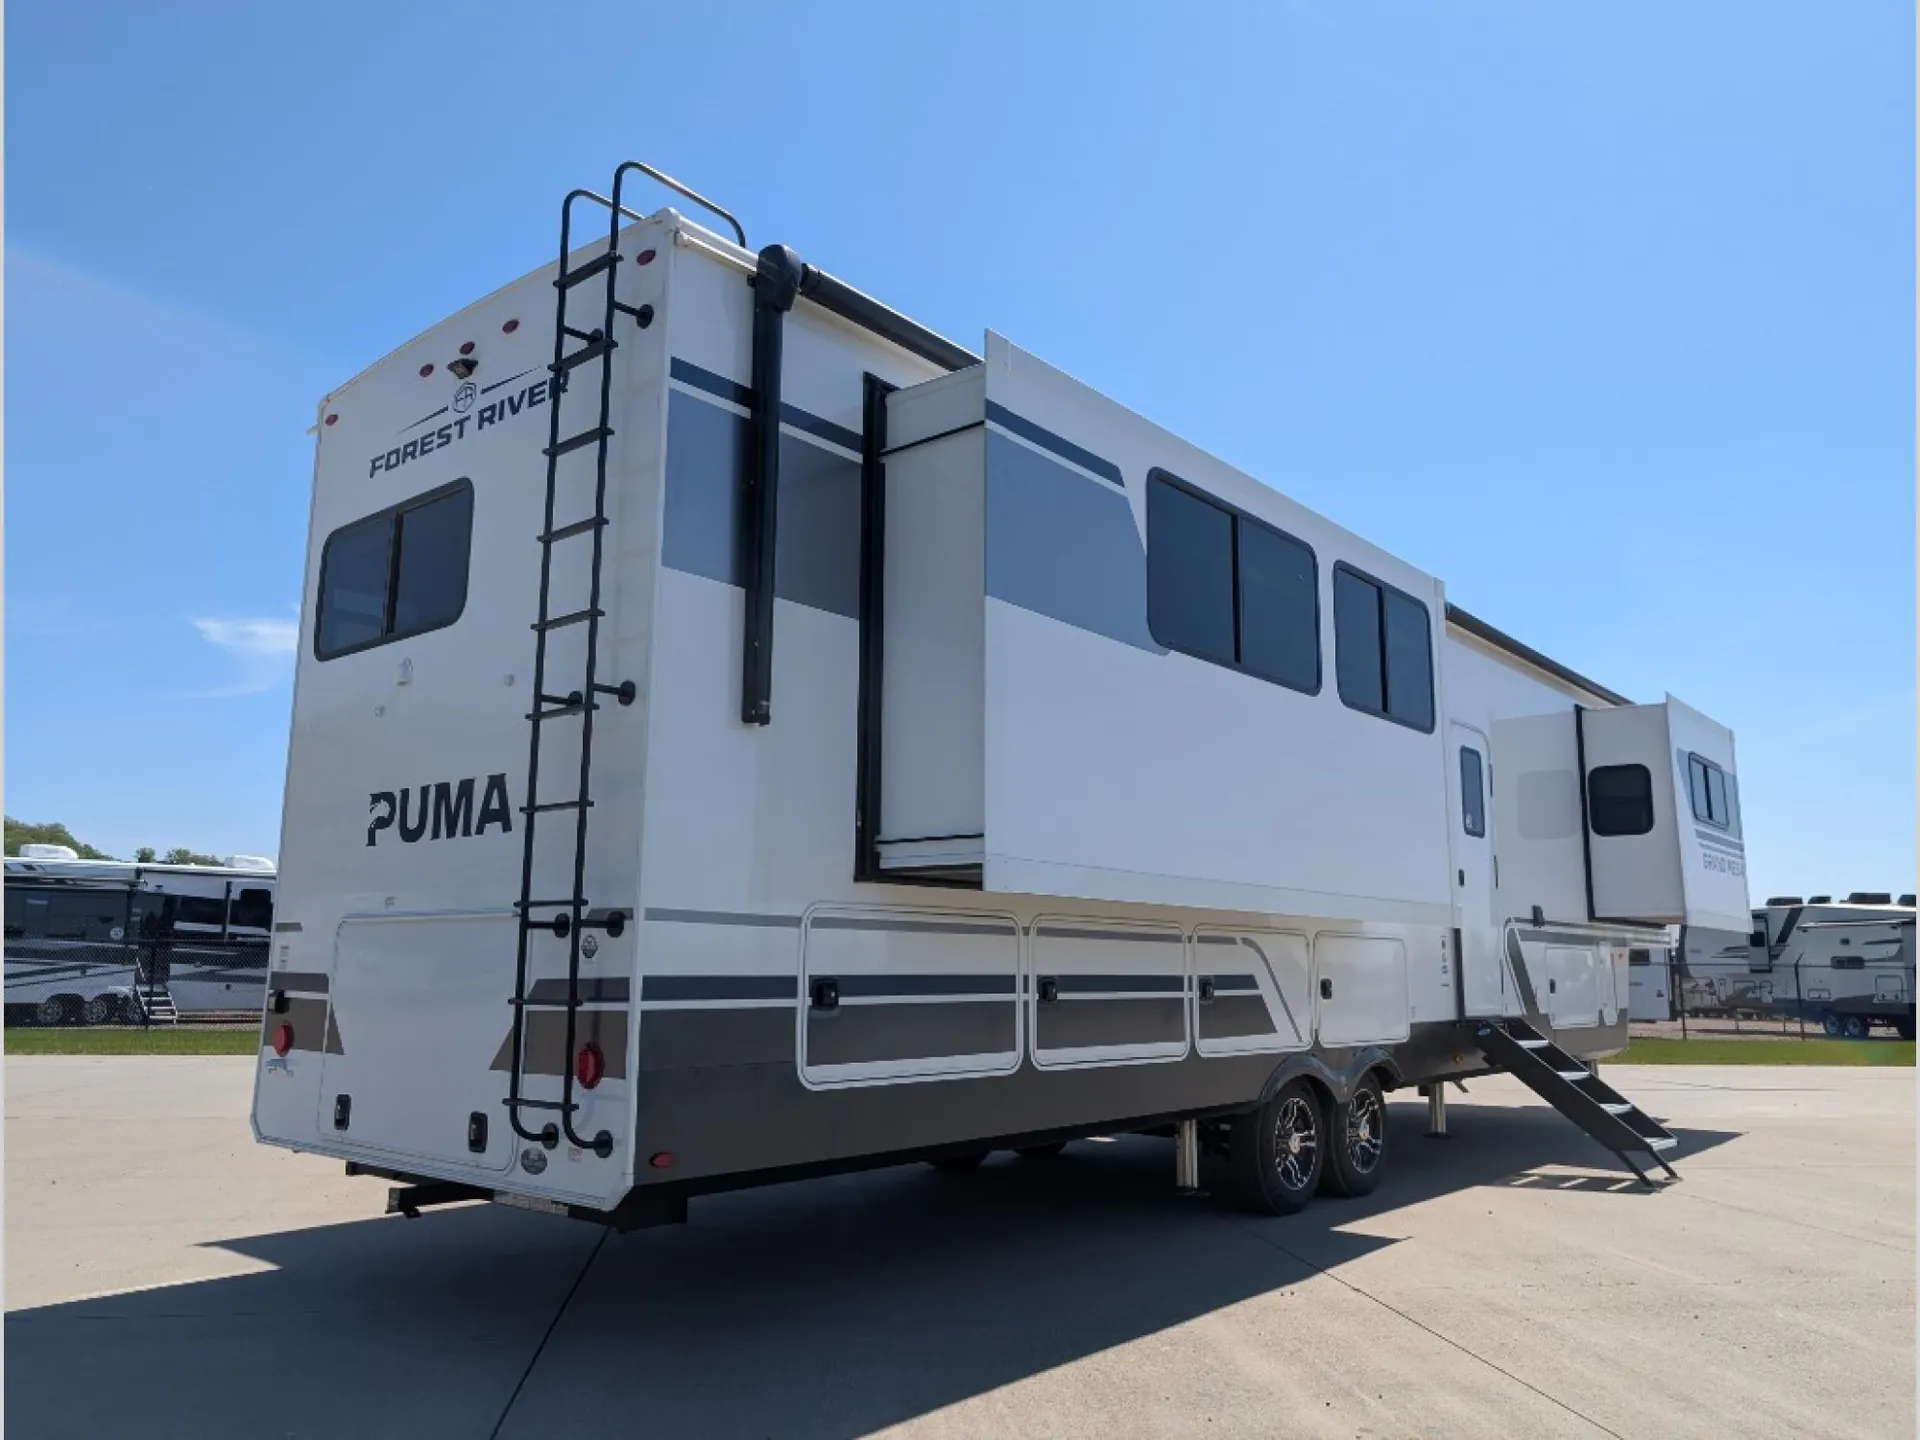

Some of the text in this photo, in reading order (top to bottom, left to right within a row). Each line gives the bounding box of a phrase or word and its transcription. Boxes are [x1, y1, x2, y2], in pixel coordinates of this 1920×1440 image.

[369, 371, 570, 479] FOREST RIVER
[366, 772, 513, 847] PUMA
